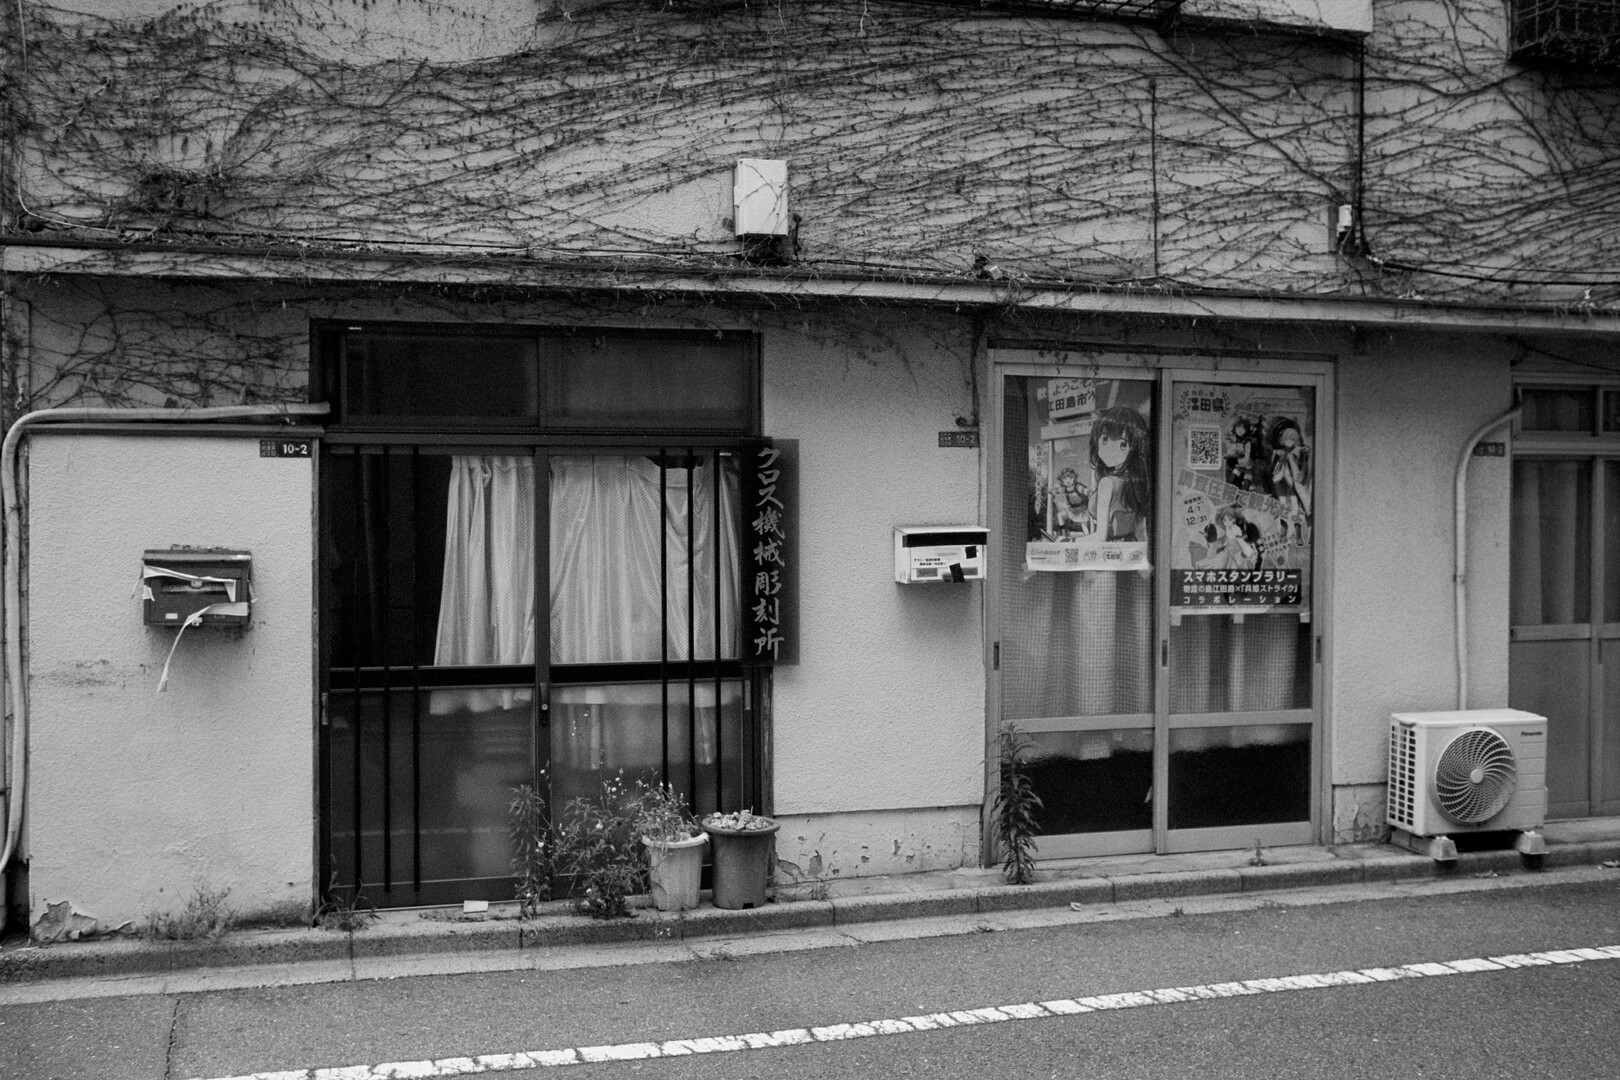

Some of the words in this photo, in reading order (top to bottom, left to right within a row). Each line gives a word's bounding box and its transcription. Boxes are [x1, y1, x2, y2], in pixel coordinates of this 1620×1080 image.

[956, 435, 975, 444] 10-2
[282, 443, 308, 455] 10-2
[1185, 514, 1208, 527] 12/31
[751, 447, 786, 662] クロス機械彫刻所
[1183, 570, 1298, 583] スマホスタンプラリー
[1183, 595, 1297, 605] コラボレーション
